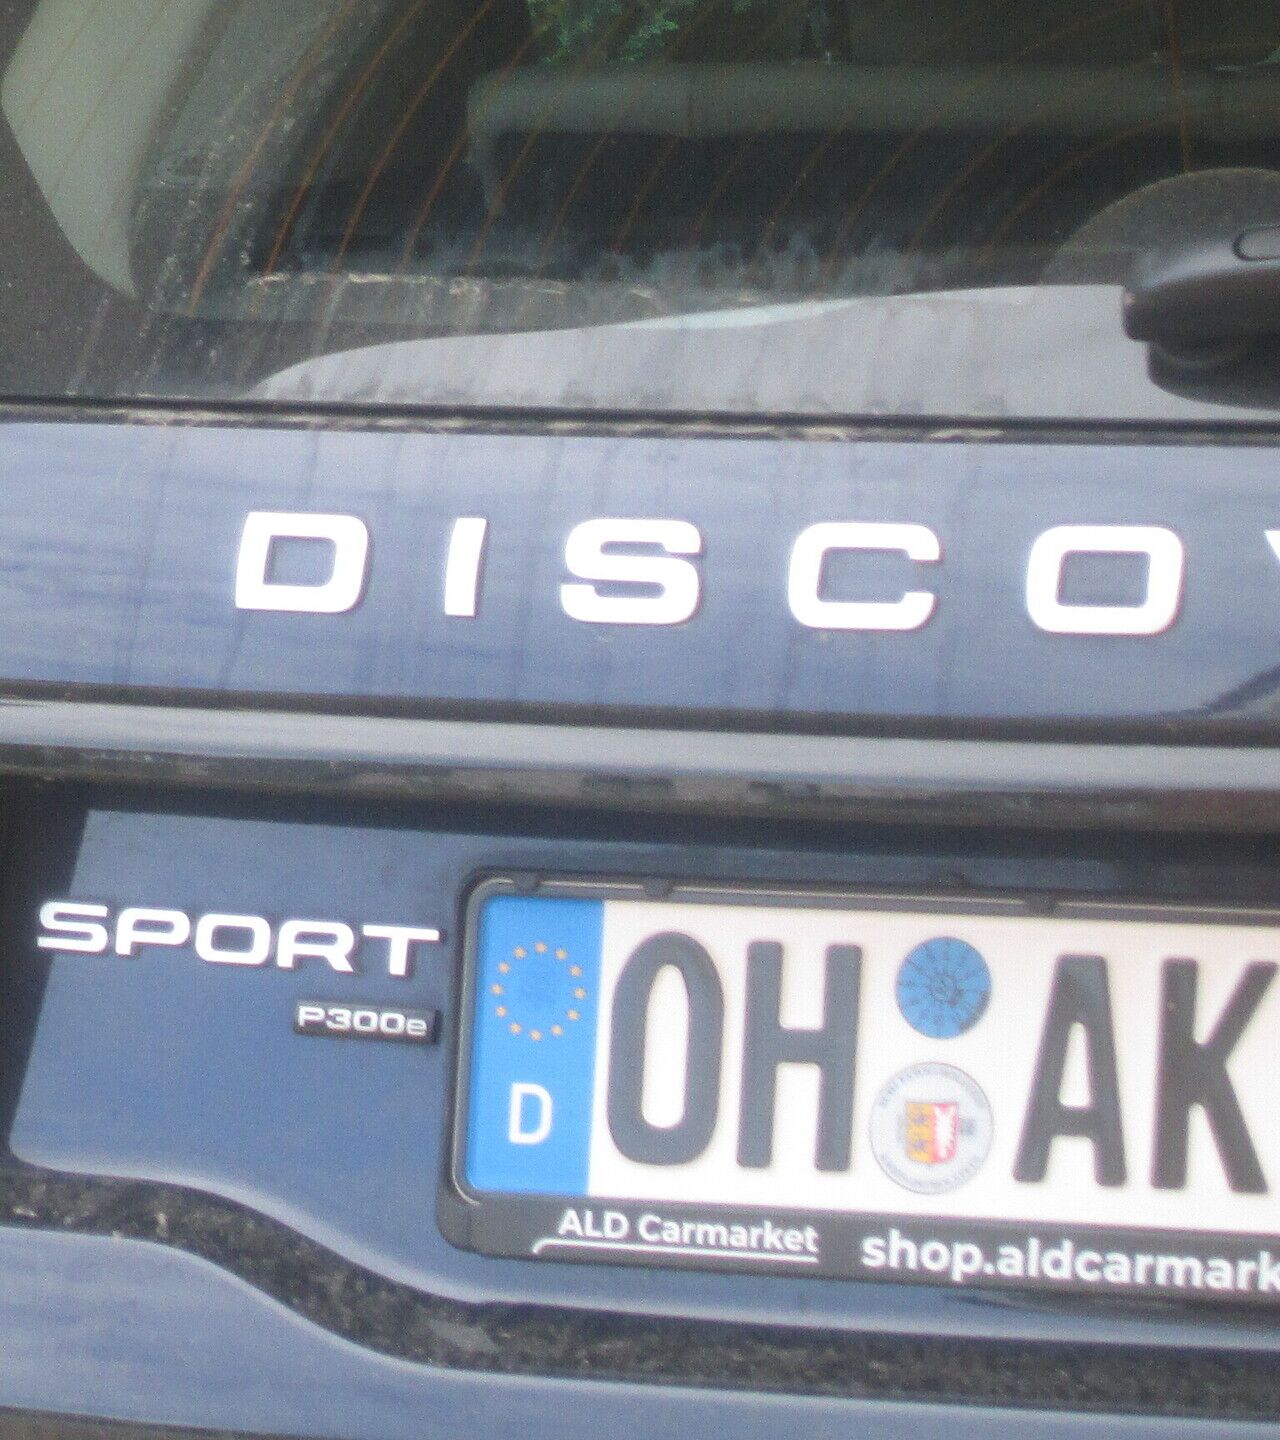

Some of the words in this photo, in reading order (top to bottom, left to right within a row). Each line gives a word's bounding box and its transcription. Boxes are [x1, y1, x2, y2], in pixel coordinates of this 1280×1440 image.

[235, 510, 1280, 634] DISCO
[37, 900, 440, 975] SPORT
[297, 1004, 428, 1036] P300e
[607, 931, 863, 1172] OH
[1013, 954, 1280, 1194] AK
[507, 1082, 553, 1145] D
[557, 1208, 629, 1239] ALD
[639, 1212, 819, 1253] Carmarket
